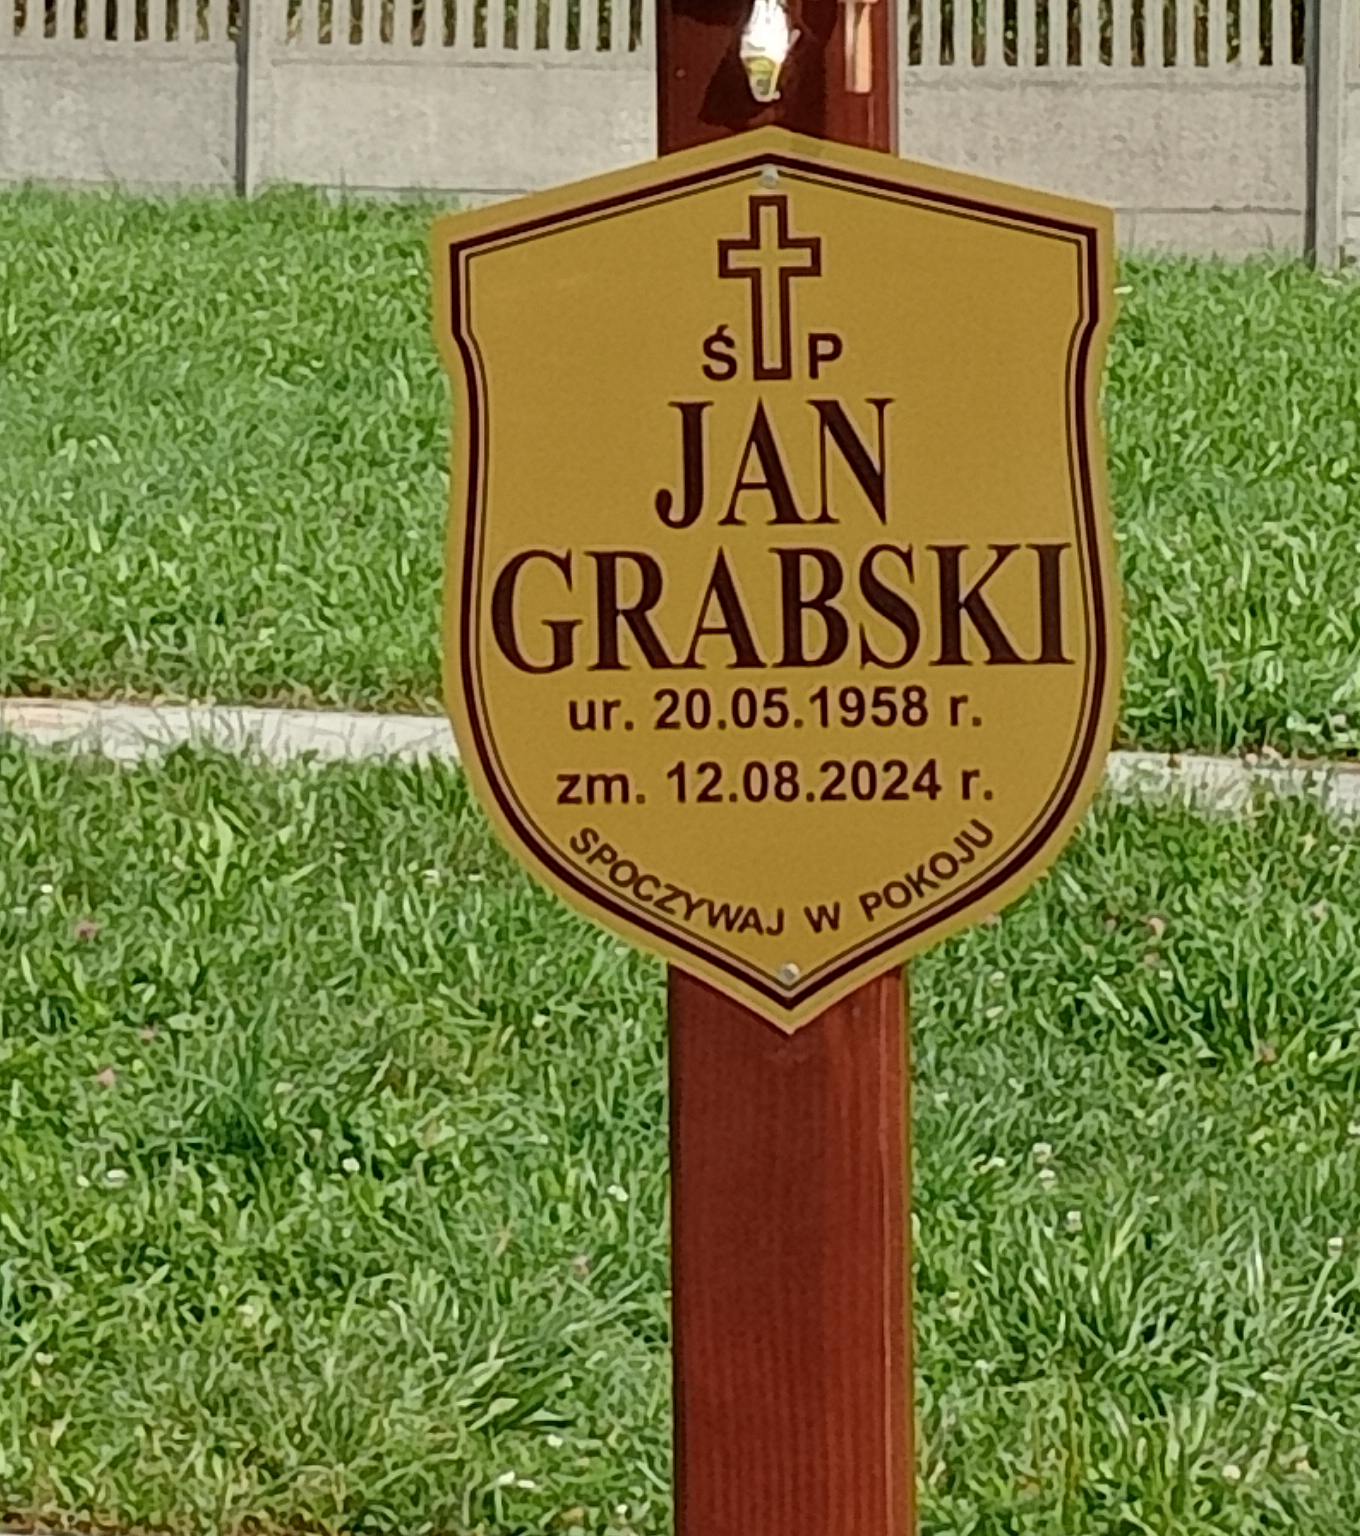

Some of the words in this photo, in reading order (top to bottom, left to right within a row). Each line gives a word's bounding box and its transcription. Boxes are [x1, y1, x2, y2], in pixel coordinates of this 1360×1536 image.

[702, 324, 738, 382] Ś
[807, 332, 843, 380] P
[654, 397, 894, 530] JAN
[490, 542, 1075, 675] GRABSKI
[569, 699, 634, 731] ur.
[653, 684, 929, 730] 20.05.1958
[950, 694, 982, 727] r.
[556, 773, 646, 806] zm.
[666, 758, 942, 804] 12.08.2024
[961, 769, 993, 801] r.
[569, 827, 785, 936] SPOCZYWAJ
[803, 901, 840, 934] W
[858, 818, 993, 922] POKOJU
